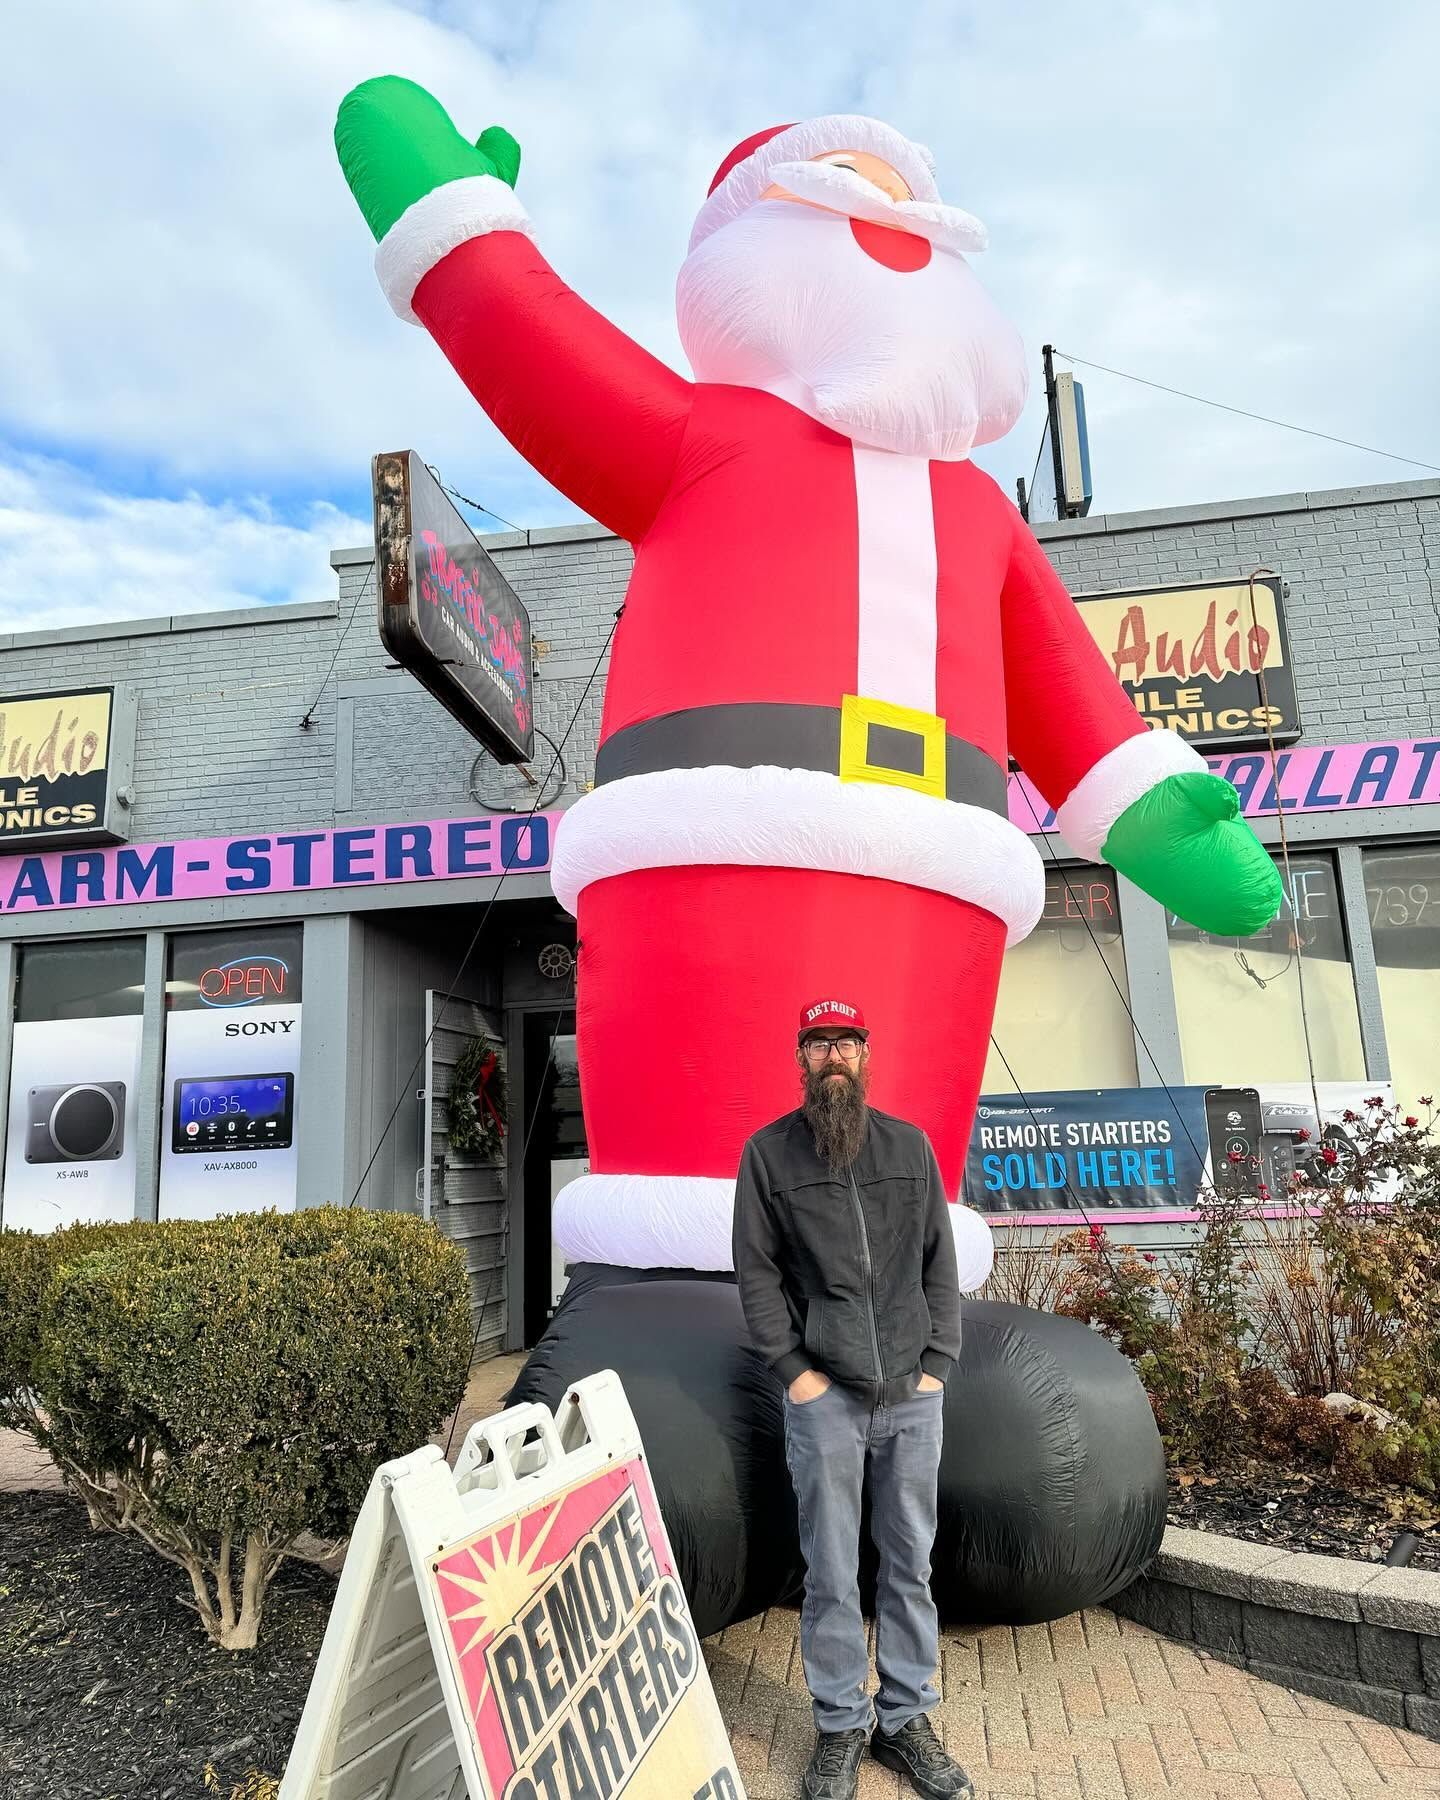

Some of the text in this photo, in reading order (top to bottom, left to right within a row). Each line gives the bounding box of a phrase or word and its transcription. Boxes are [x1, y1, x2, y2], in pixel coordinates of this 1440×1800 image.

[441, 606, 455, 633] CAR
[1112, 600, 1270, 683] Audio
[1208, 741, 1440, 813] ALLAT
[0, 803, 96, 830] NICS
[0, 815, 549, 909] ARM-STEREO
[200, 967, 284, 996] OPEN
[806, 1001, 857, 1021] DETROIT
[225, 1020, 295, 1037] SONY
[189, 1095, 240, 1115] 10:35
[980, 1120, 1172, 1149] REMOTE STARTERS
[56, 1170, 89, 1179] XS-AW8
[203, 1161, 257, 1172] XAV-AX8000
[982, 1149, 1177, 1191] SOLD HERE!
[493, 1496, 656, 1755] REMOTE
[510, 1582, 695, 1800] TARTERS
